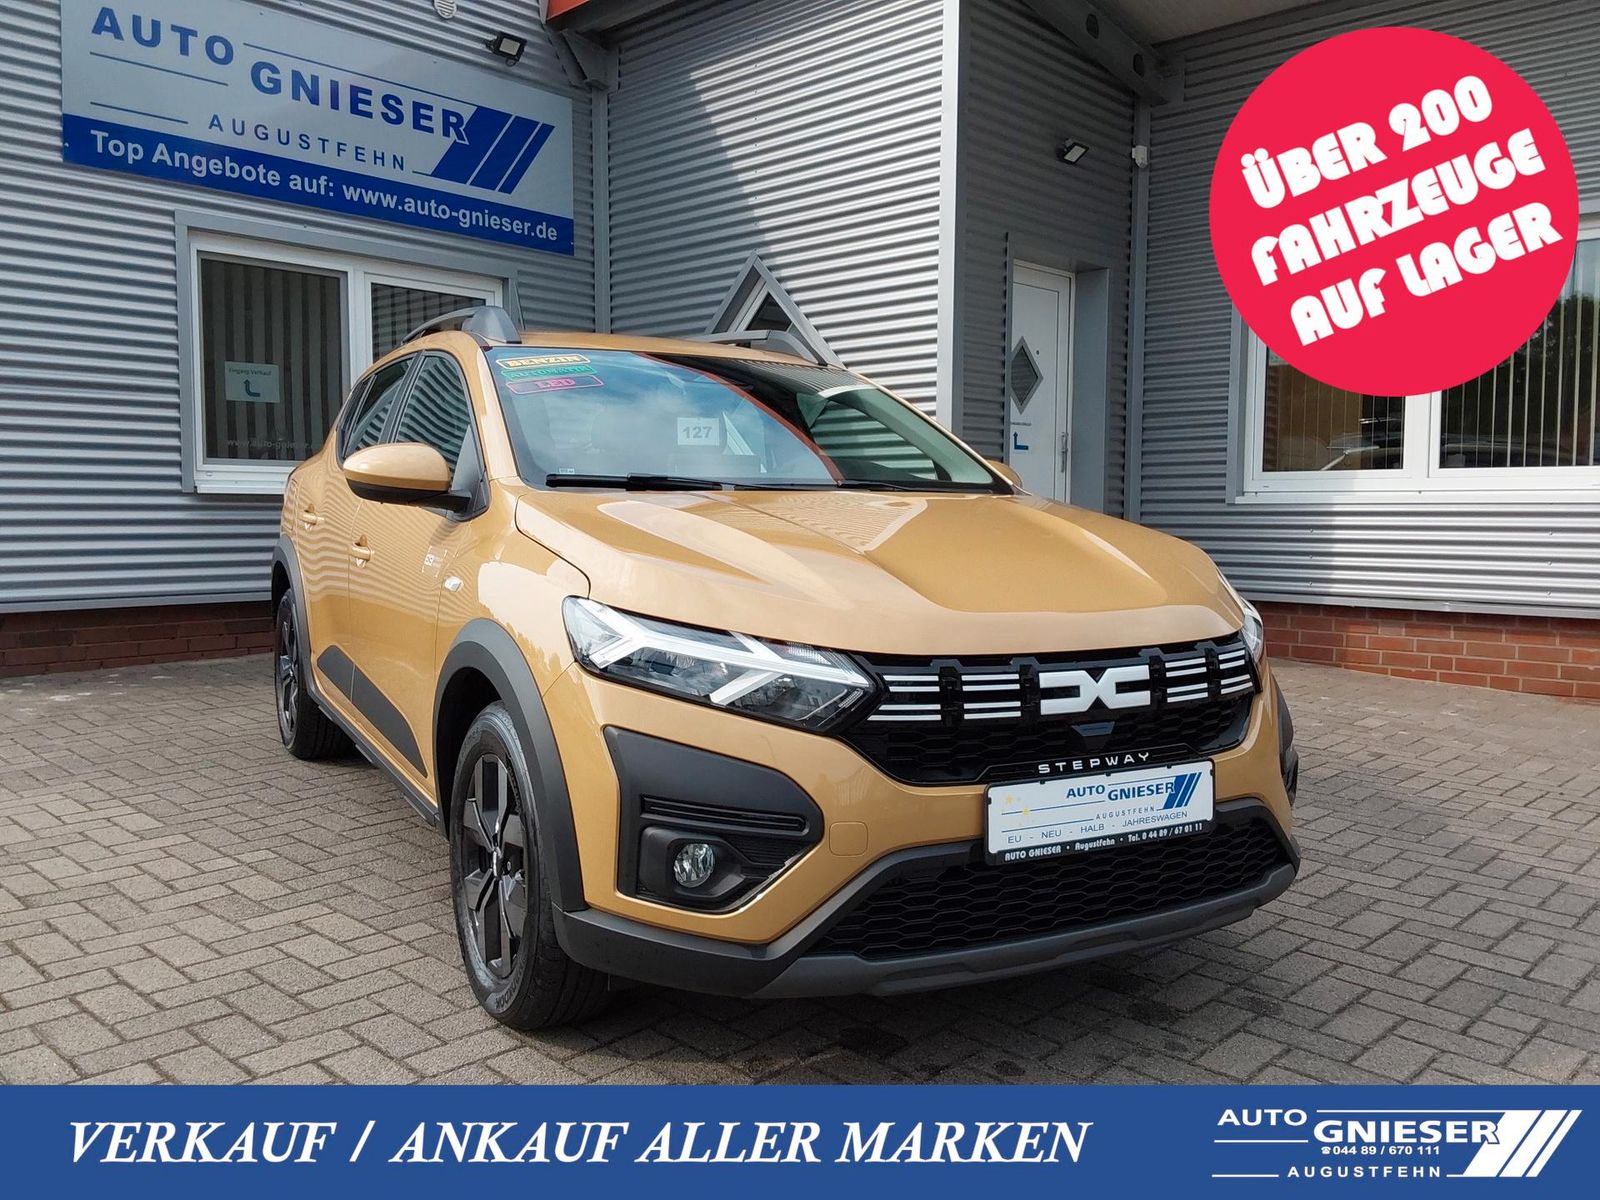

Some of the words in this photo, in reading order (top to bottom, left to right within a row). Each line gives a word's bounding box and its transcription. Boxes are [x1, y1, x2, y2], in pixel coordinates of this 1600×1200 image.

[91, 7, 234, 65] AUTO
[250, 61, 470, 145] GNIESER
[208, 114, 405, 171] AUGUSTFEHN
[90, 129, 144, 164] Top
[152, 142, 281, 187] Angebote
[288, 174, 334, 197] auf:
[343, 185, 558, 241] www.auto-gnieser.de
[507, 356, 580, 368] BENZIN
[534, 378, 576, 389] LED
[682, 426, 712, 439] 127
[1038, 752, 1149, 774] STEPWAY
[1066, 784, 1106, 799] AUTO
[1108, 781, 1175, 802] GNIESER
[1096, 805, 1155, 820] AUGUSTFEHN
[1007, 834, 1022, 844] EU
[1041, 829, 1062, 840] NEU
[1080, 823, 1105, 834] HALB
[1122, 811, 1188, 828] JAHRESWAGEN
[1004, 851, 1026, 862] AUTO
[1075, 837, 1115, 851] Augustfehn
